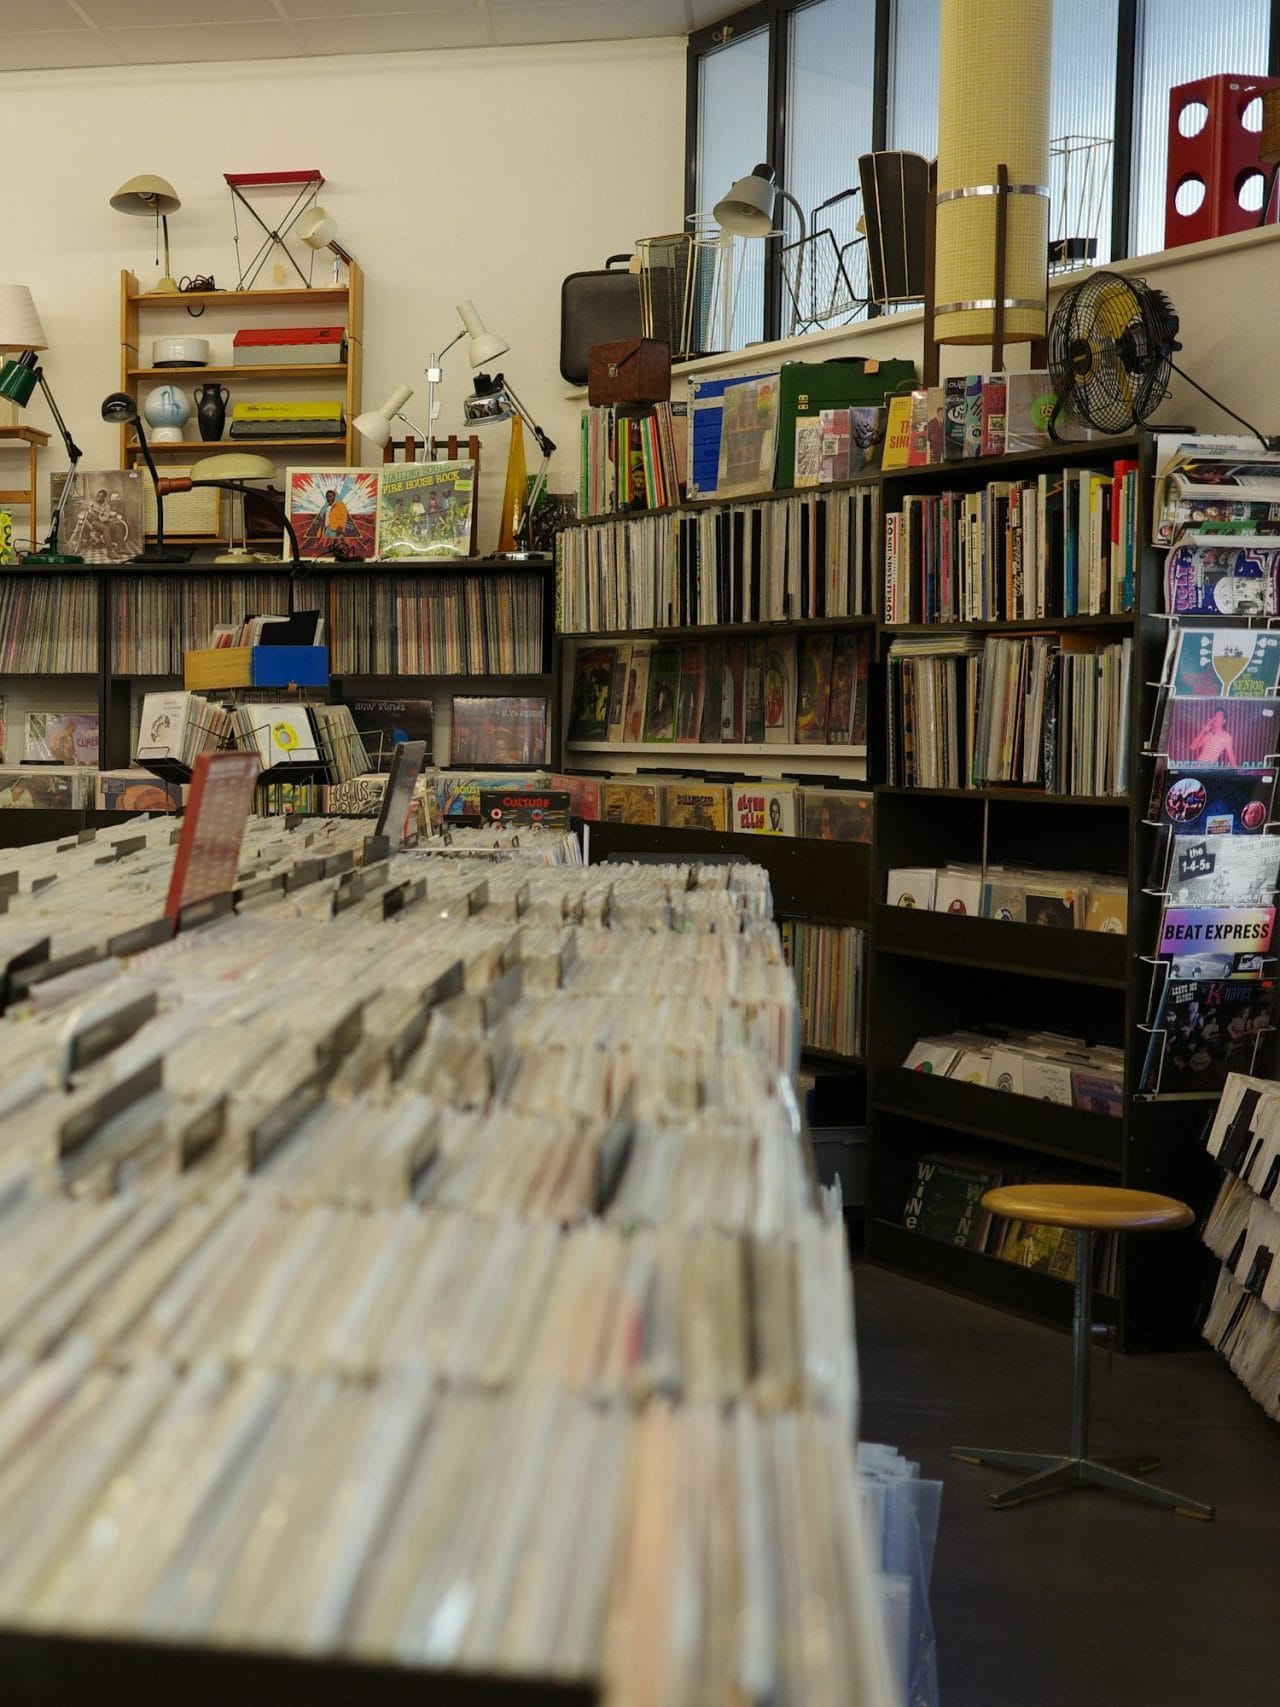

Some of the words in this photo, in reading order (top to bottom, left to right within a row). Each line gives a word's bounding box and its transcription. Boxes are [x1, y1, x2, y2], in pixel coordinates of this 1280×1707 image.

[383, 468, 420, 483] WAILING
[422, 463, 450, 477] SOULS
[382, 482, 404, 496] FIRE
[406, 476, 434, 491] HOUSE
[436, 470, 461, 484] ROCK
[1175, 566, 1189, 611] UGLY
[1232, 678, 1265, 693] SENIOR
[502, 796, 551, 808] CULTURE
[740, 812, 765, 829] ELLIS
[1188, 846, 1204, 859] the
[1164, 924, 1203, 940] BEAT
[1204, 923, 1270, 941] EXPRESS
